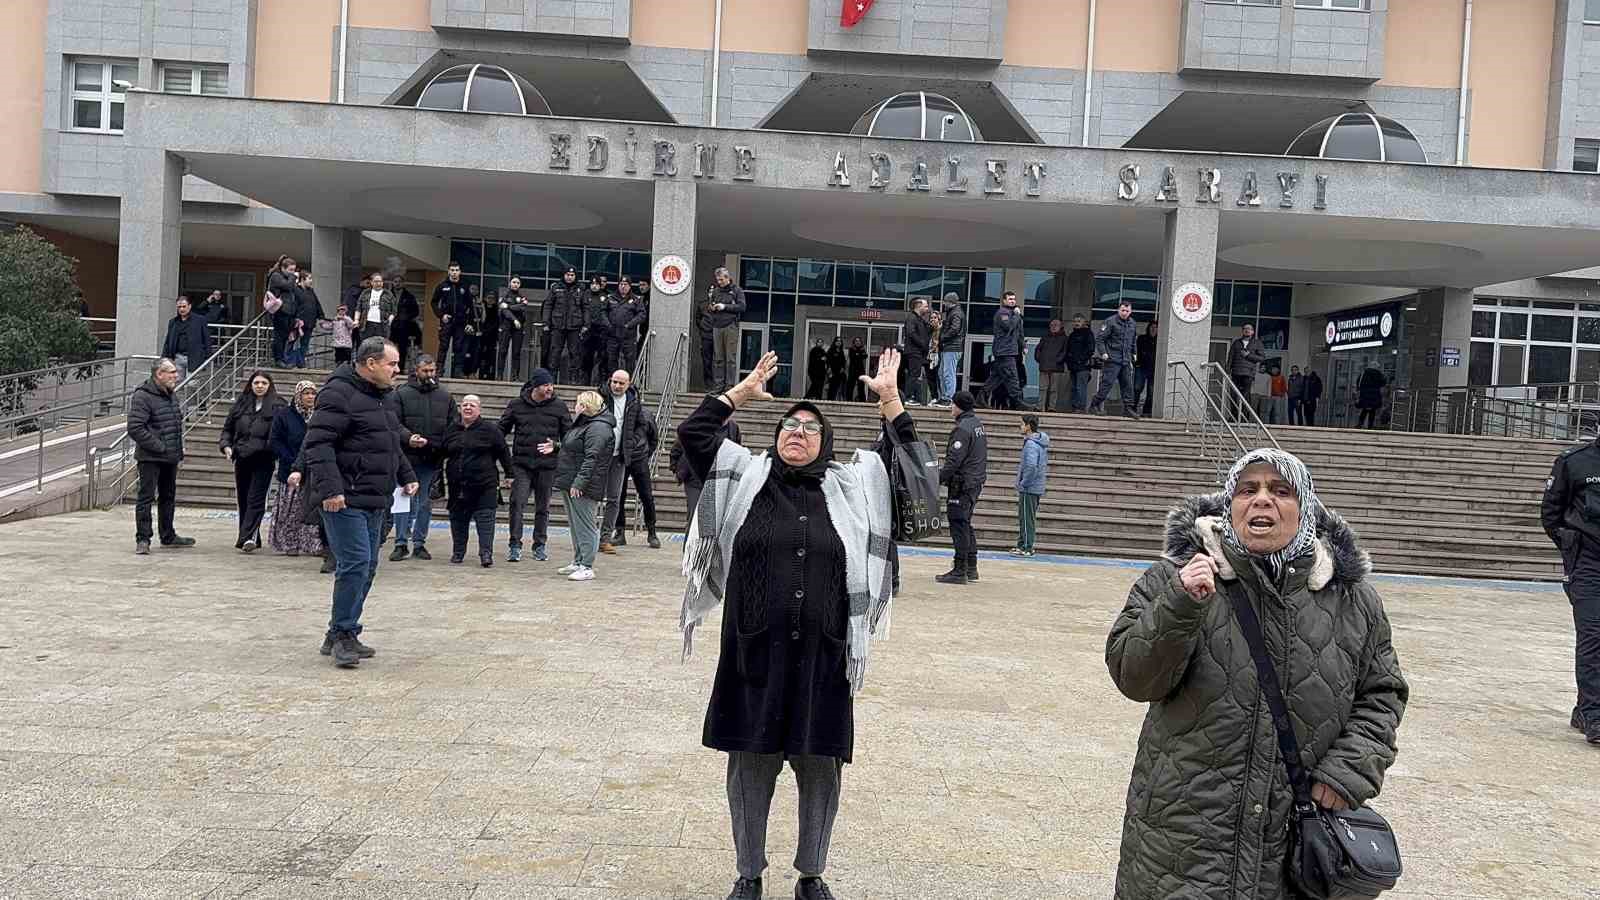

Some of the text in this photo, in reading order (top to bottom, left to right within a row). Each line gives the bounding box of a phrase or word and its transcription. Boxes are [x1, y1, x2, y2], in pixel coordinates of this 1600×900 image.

[549, 127, 1328, 209] EDİRNE ADALET SARAYI
[904, 517, 940, 534] SHO
